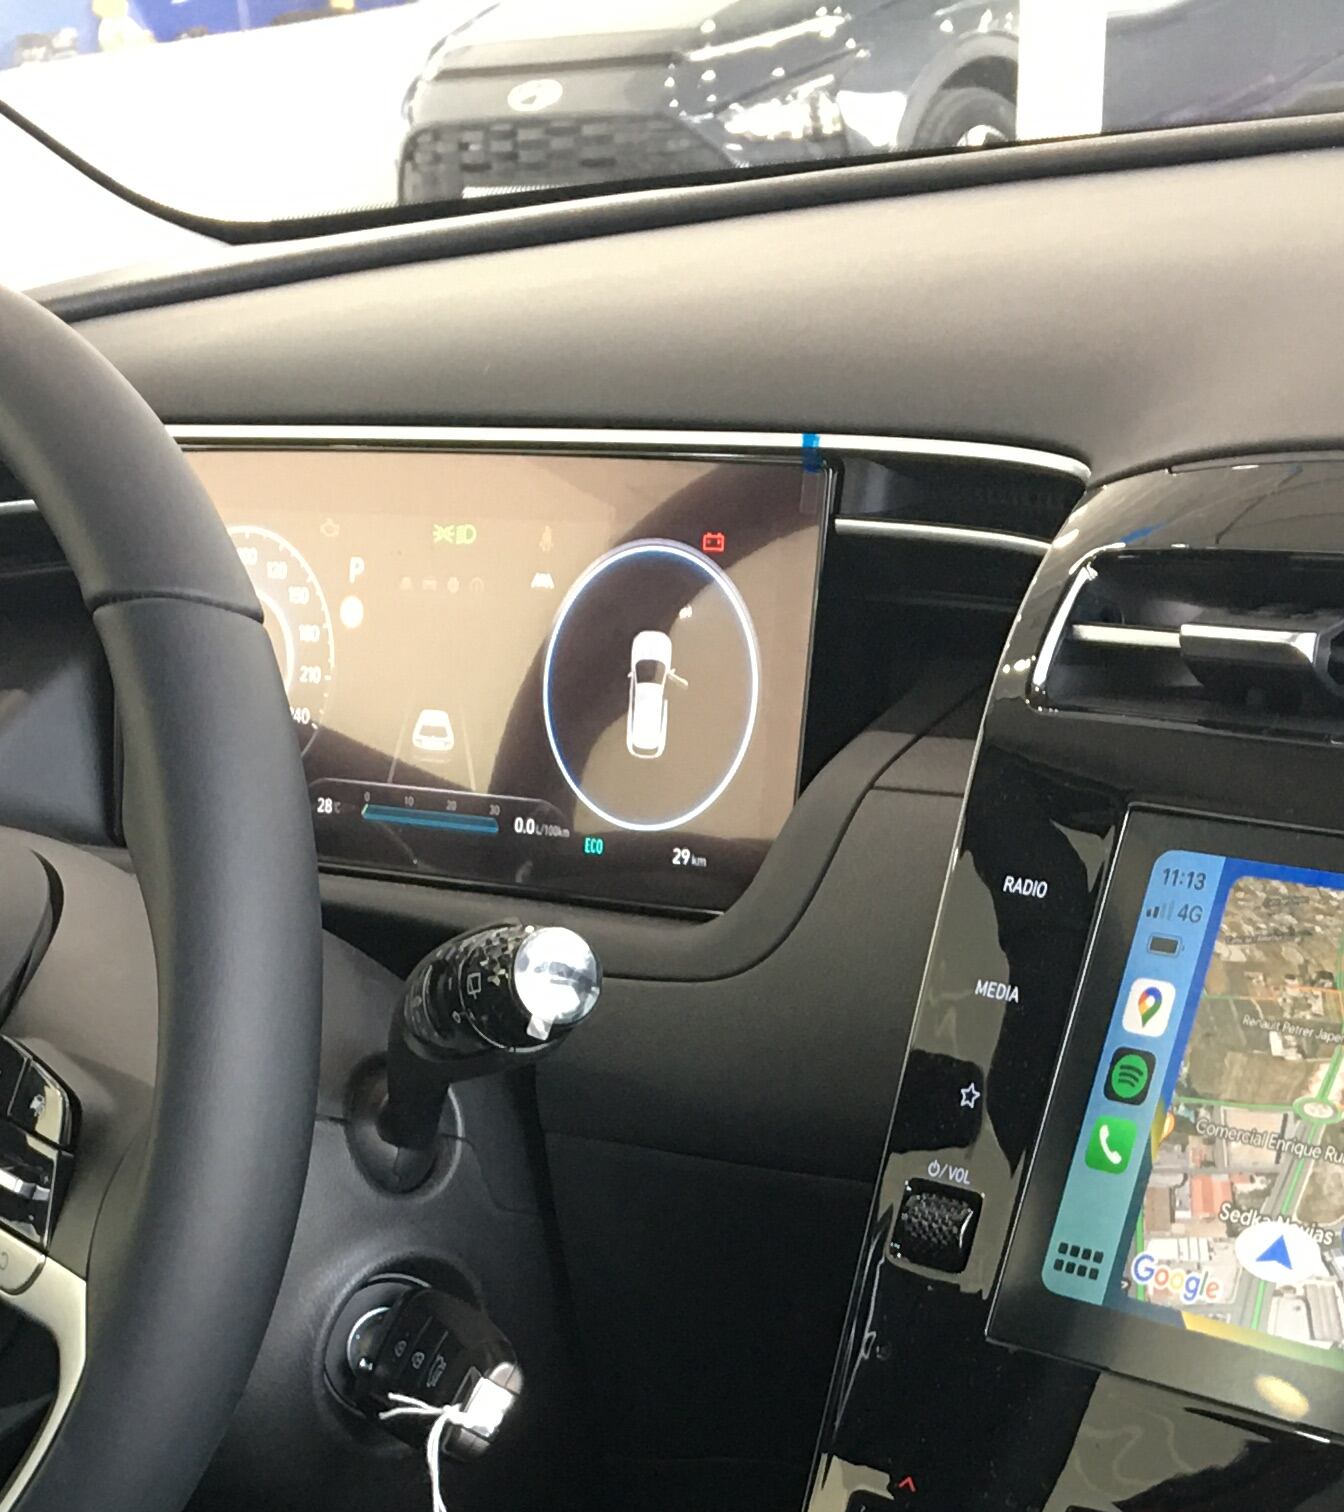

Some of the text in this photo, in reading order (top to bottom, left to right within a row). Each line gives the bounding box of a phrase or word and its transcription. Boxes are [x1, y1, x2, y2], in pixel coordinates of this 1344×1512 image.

[349, 556, 365, 584] P
[299, 665, 321, 684] 210
[404, 796, 415, 807] 10
[584, 837, 604, 855] ECO
[672, 847, 690, 865] 29
[1003, 875, 1048, 899] RADIO
[1162, 867, 1206, 890] 11:13
[1177, 904, 1203, 923] 4G
[975, 979, 1020, 1003] MEDIA
[1196, 1118, 1266, 1148] Comercial
[1268, 1136, 1322, 1160] Enrique
[1133, 1253, 1221, 1301] Google
